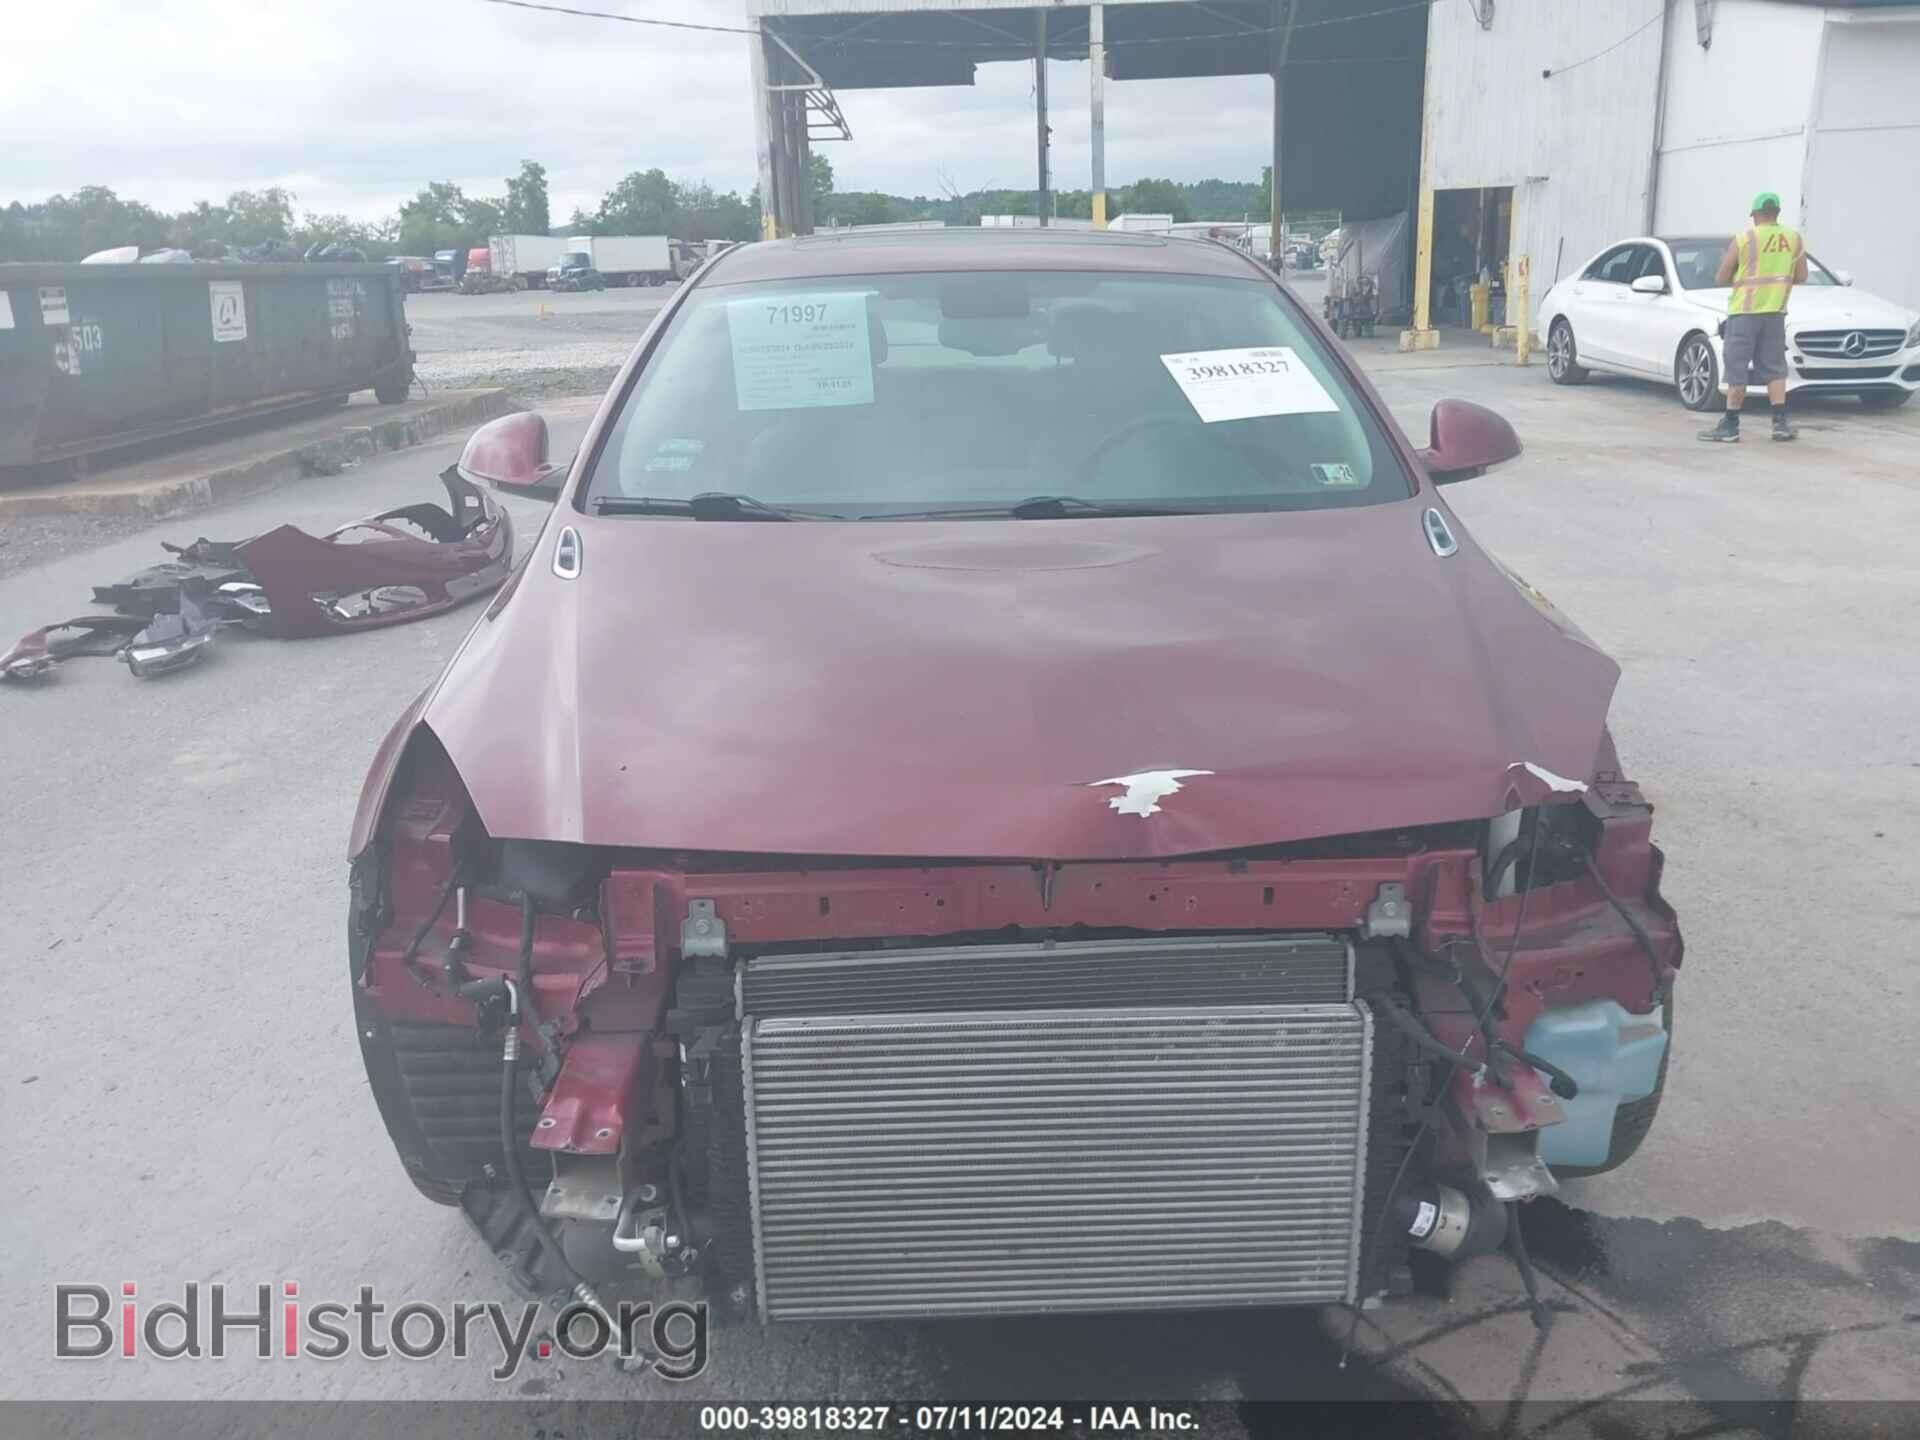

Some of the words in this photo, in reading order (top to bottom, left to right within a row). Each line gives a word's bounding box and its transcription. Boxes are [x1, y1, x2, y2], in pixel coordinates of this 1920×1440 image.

[766, 304, 828, 325] 71997
[71, 325, 102, 352] 503
[1186, 361, 1290, 381] 39818327
